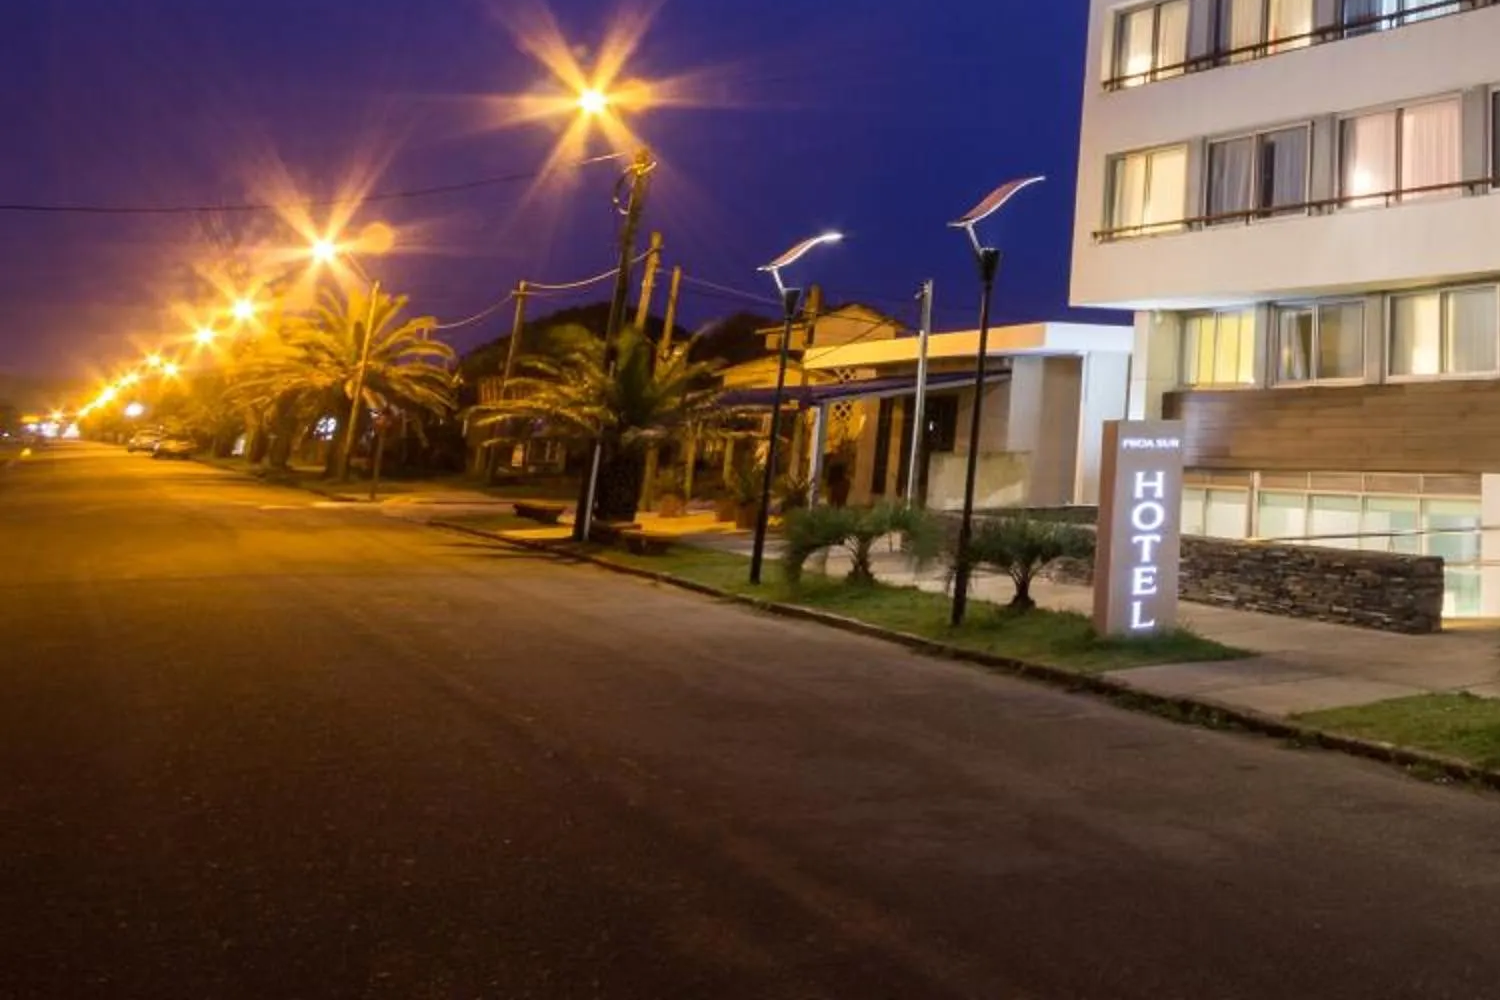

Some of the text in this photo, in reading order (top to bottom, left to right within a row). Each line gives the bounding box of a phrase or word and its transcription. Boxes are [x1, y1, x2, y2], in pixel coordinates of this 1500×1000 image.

[1122, 438, 1179, 449] PROA SUR
[1130, 470, 1166, 629] HOTEL
